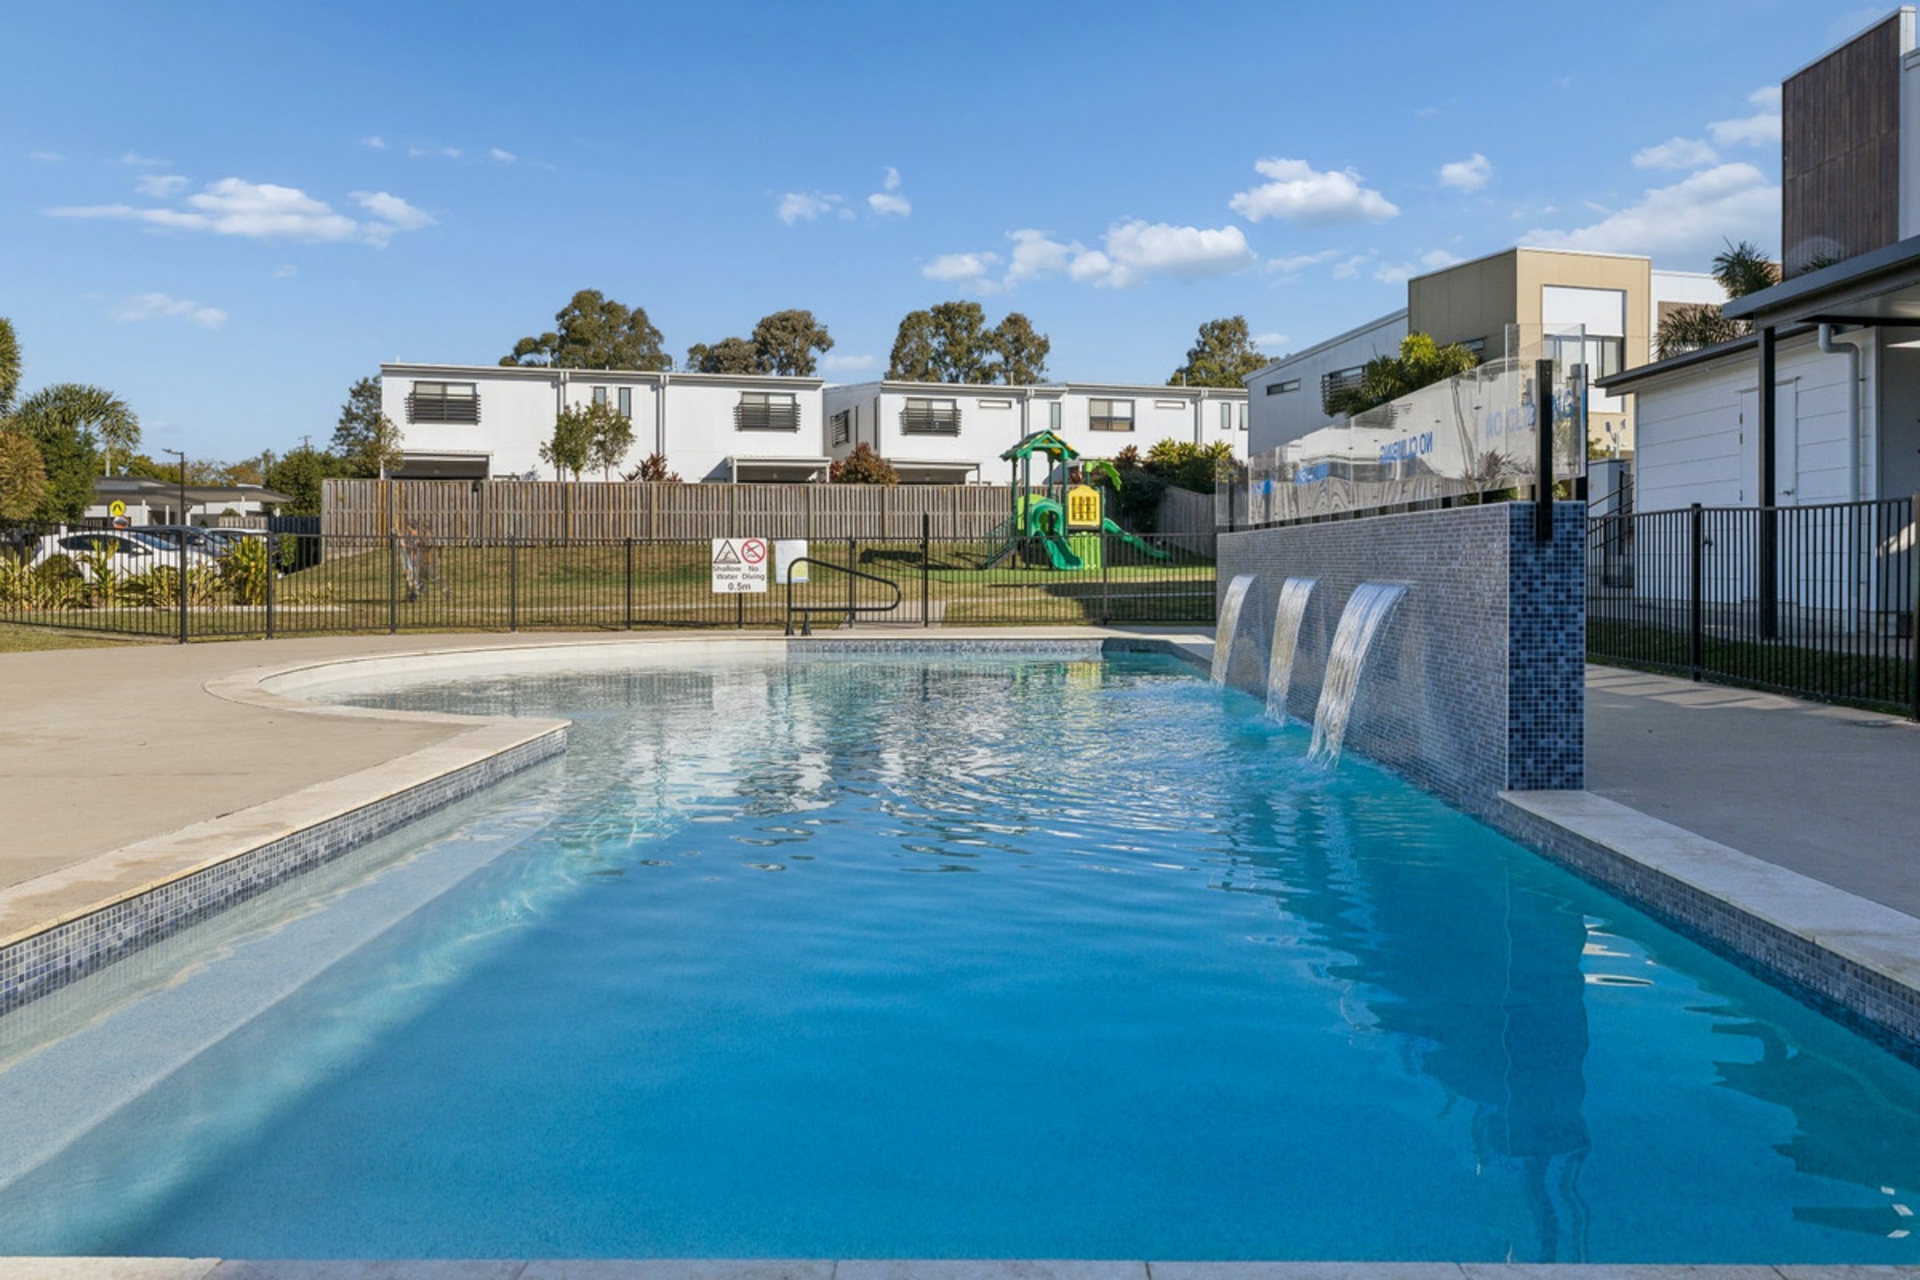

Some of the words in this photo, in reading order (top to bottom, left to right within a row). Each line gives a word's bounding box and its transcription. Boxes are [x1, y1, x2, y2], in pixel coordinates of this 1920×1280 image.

[1485, 409, 1503, 439] NO
[742, 573, 765, 581] Diving
[728, 582, 751, 591] 0.5m
